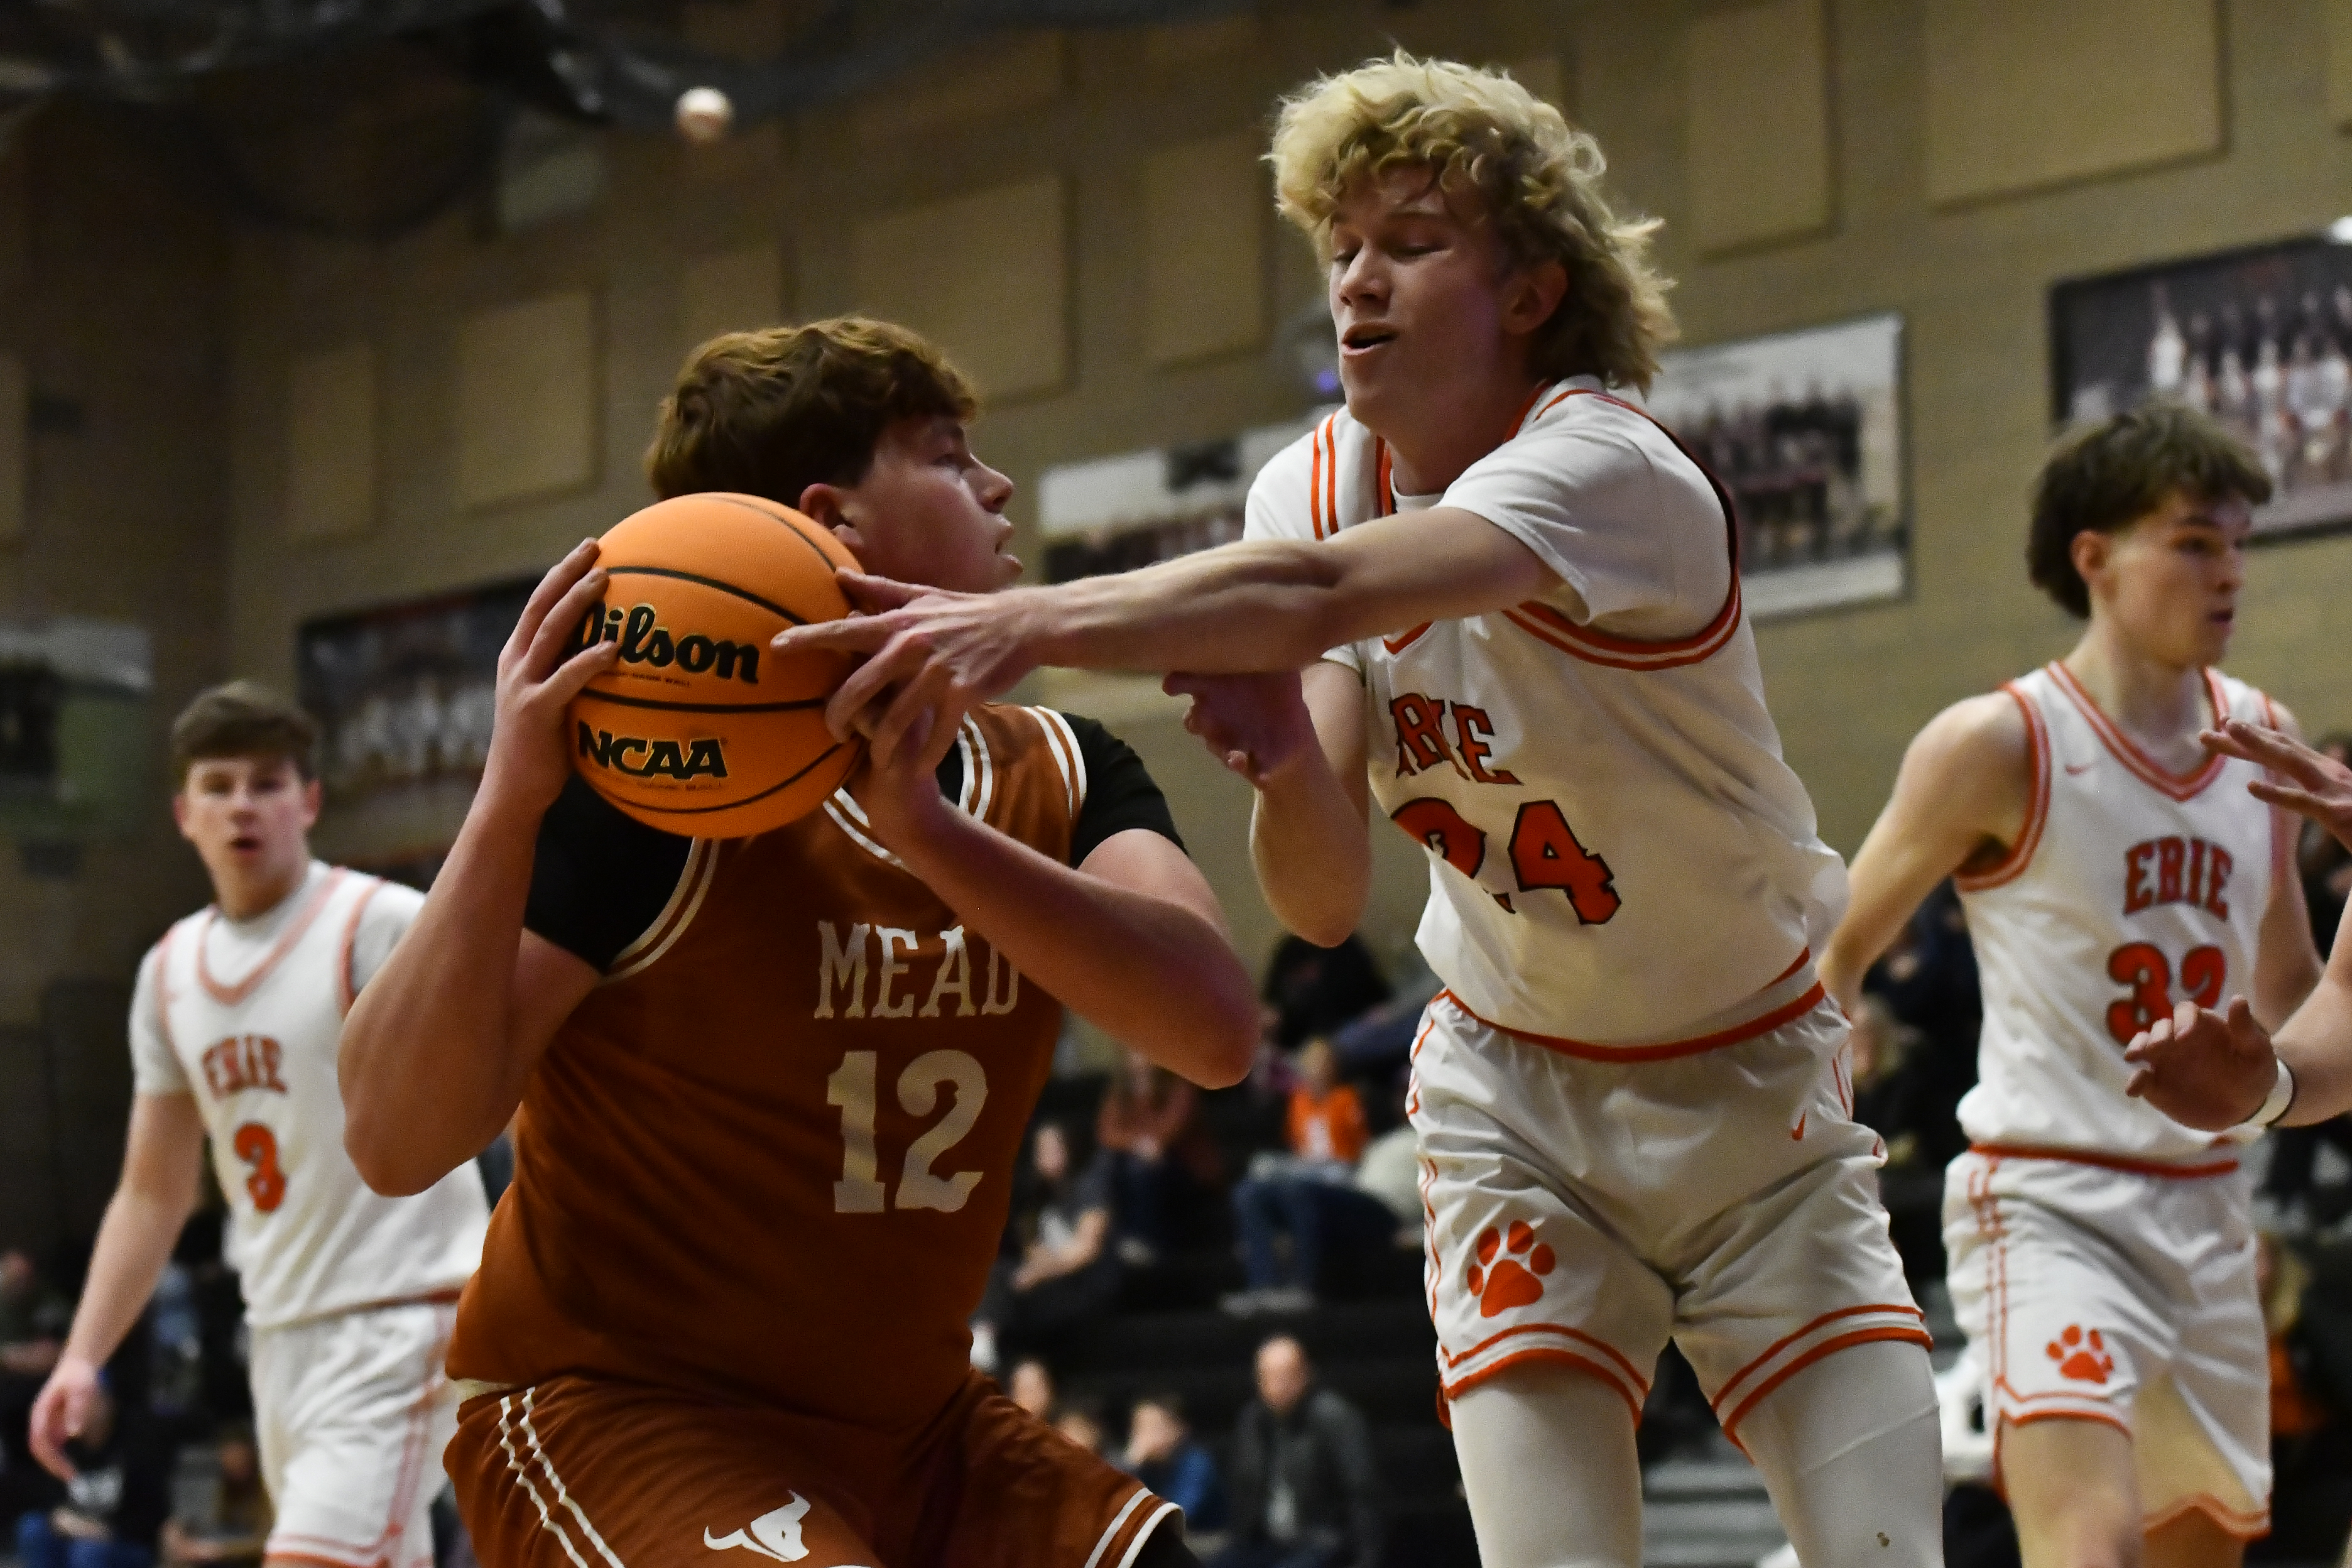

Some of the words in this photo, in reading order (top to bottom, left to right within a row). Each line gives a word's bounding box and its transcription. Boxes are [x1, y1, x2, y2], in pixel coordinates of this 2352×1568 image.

[579, 720, 728, 779] NCAA
[1389, 693, 1524, 785] RIE
[2123, 837, 2233, 920] ERIE
[814, 920, 1019, 1019] MEAD
[2107, 942, 2226, 1046] 32
[234, 1123, 287, 1213] 3
[827, 1049, 989, 1214] 12
